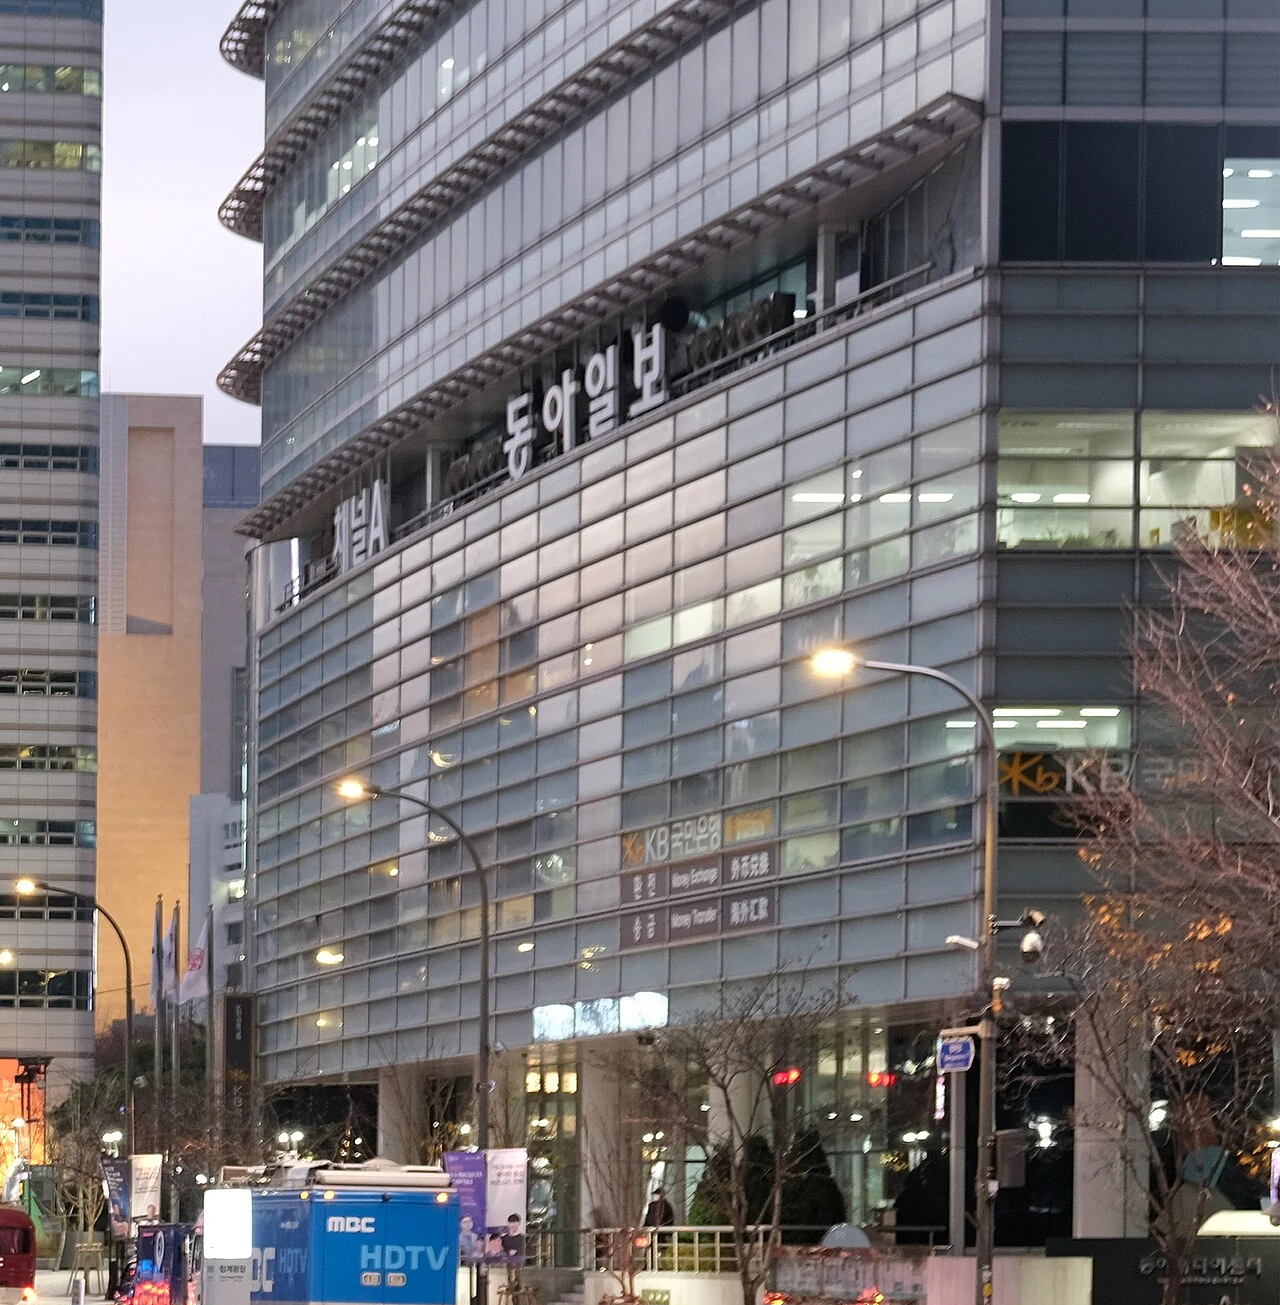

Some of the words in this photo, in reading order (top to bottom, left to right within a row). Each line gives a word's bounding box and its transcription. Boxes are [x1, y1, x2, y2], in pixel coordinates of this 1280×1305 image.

[503, 322, 668, 481] 동아일보
[332, 479, 389, 578] 채널A
[644, 812, 722, 865] KB국민은행
[326, 1216, 376, 1234] MBC
[219, 1264, 247, 1274] 청계광장
[279, 1247, 309, 1274] HDTV
[360, 1245, 450, 1271] HDTV
